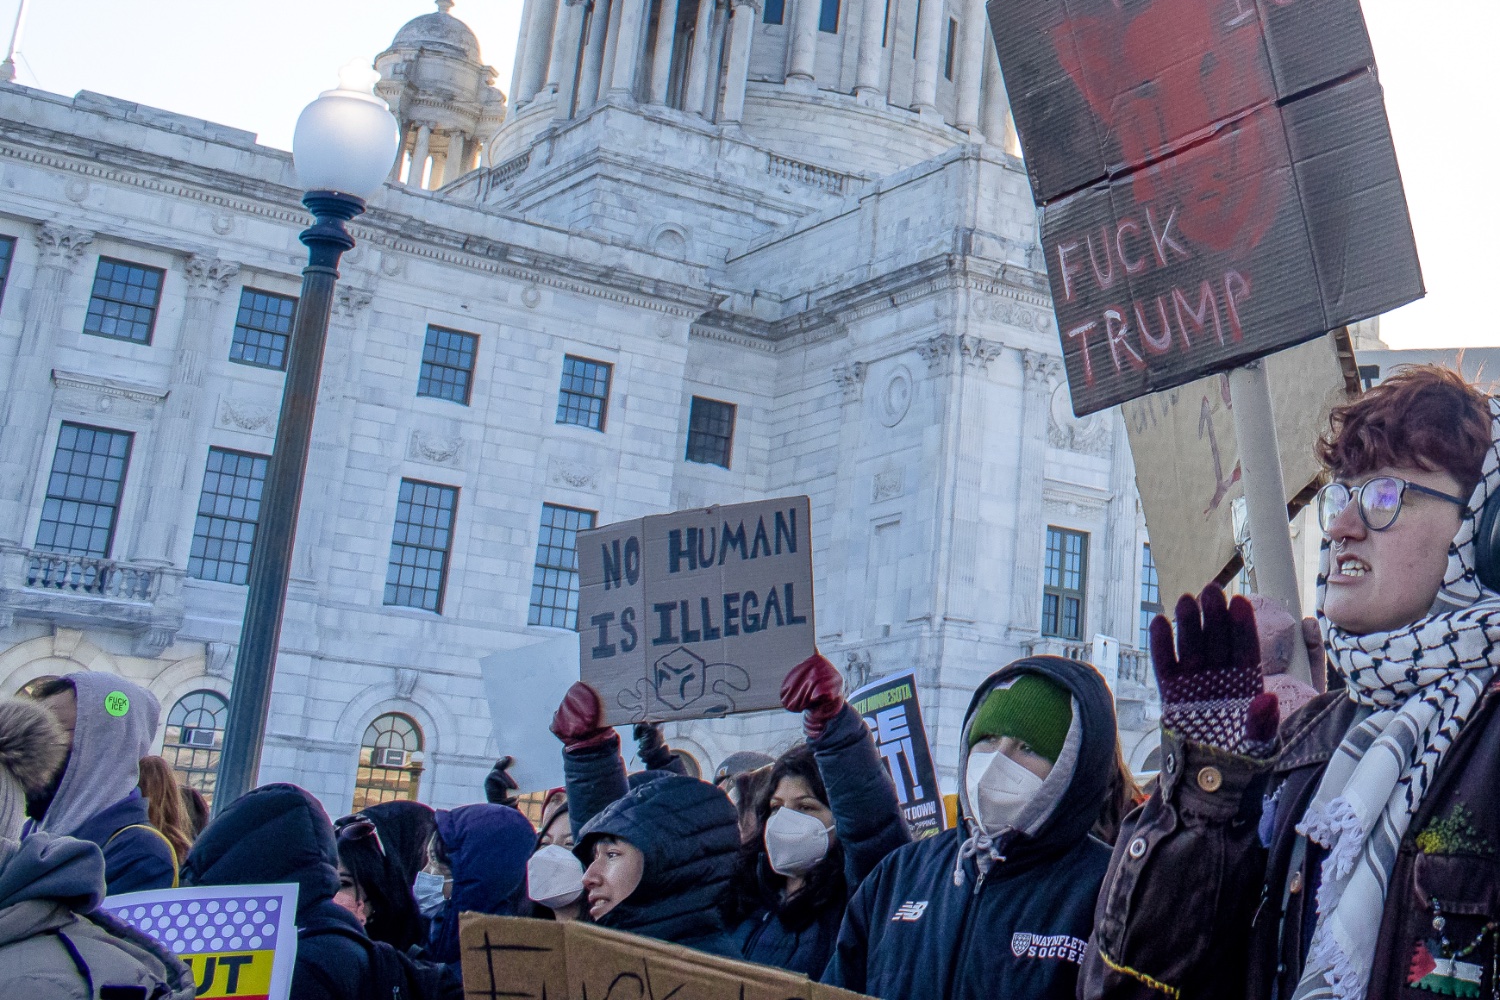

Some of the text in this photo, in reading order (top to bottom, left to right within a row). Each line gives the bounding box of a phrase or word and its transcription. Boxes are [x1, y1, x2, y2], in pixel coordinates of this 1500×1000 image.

[1056, 204, 1191, 302] FUCK
[1067, 268, 1252, 388] TRUMP
[601, 507, 798, 591] NO HUMAN
[590, 581, 807, 660] IS ILLEGAL
[108, 695, 128, 706] FUCK
[111, 703, 124, 712] ICE
